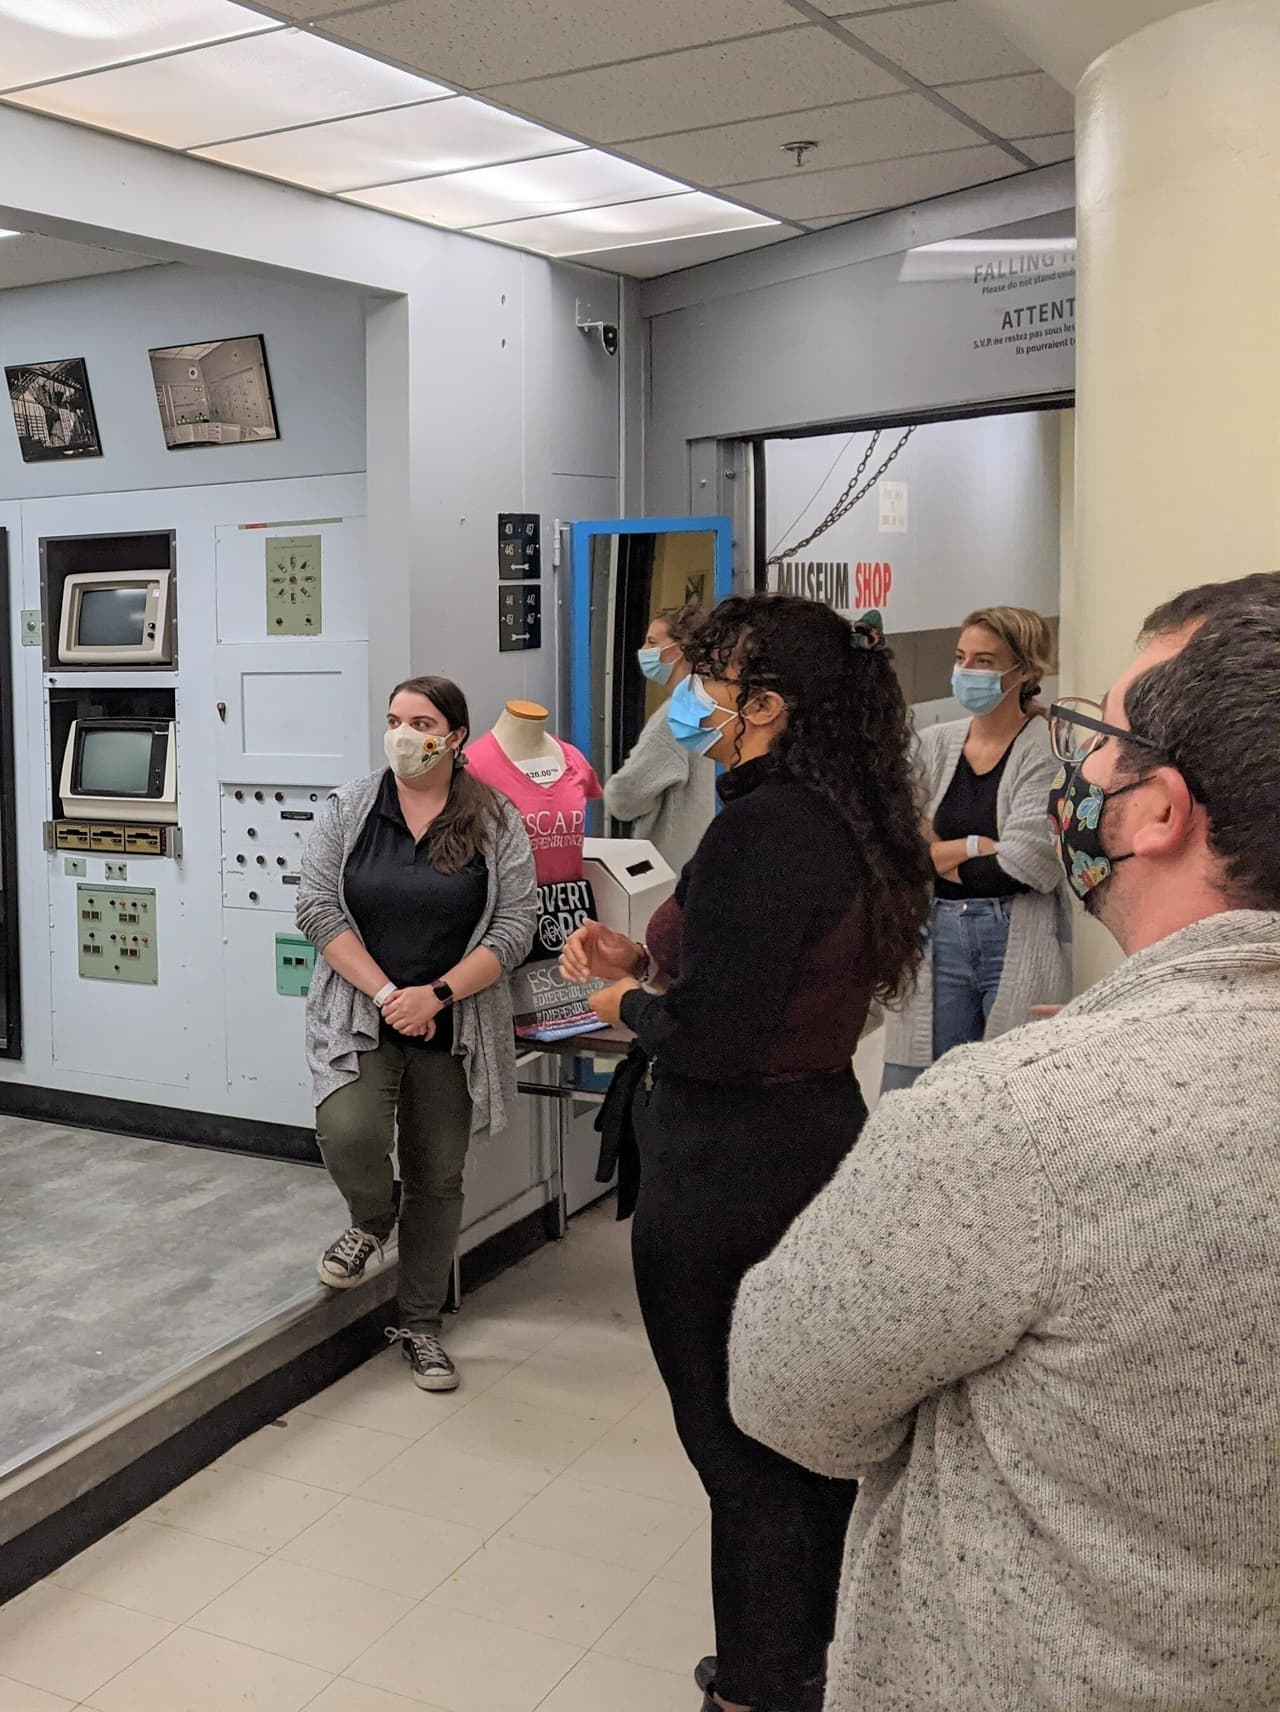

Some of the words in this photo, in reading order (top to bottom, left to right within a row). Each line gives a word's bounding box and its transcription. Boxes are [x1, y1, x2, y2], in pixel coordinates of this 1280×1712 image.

[974, 255, 1055, 284] FALLING
[982, 283, 1005, 295] Please
[1007, 279, 1018, 290] do
[1019, 279, 1032, 288] not
[1035, 273, 1056, 285] stand
[1001, 296, 1076, 331] ATTENT
[994, 337, 1003, 346] ne
[1005, 332, 1028, 344] restez
[1029, 330, 1043, 341] pas
[1044, 326, 1062, 337] sous
[1026, 337, 1068, 355] pourraient
[777, 561, 849, 609] MUSEUM
[855, 561, 892, 609] SHOP
[521, 810, 586, 838] SCAP
[527, 965, 567, 994] ESC
